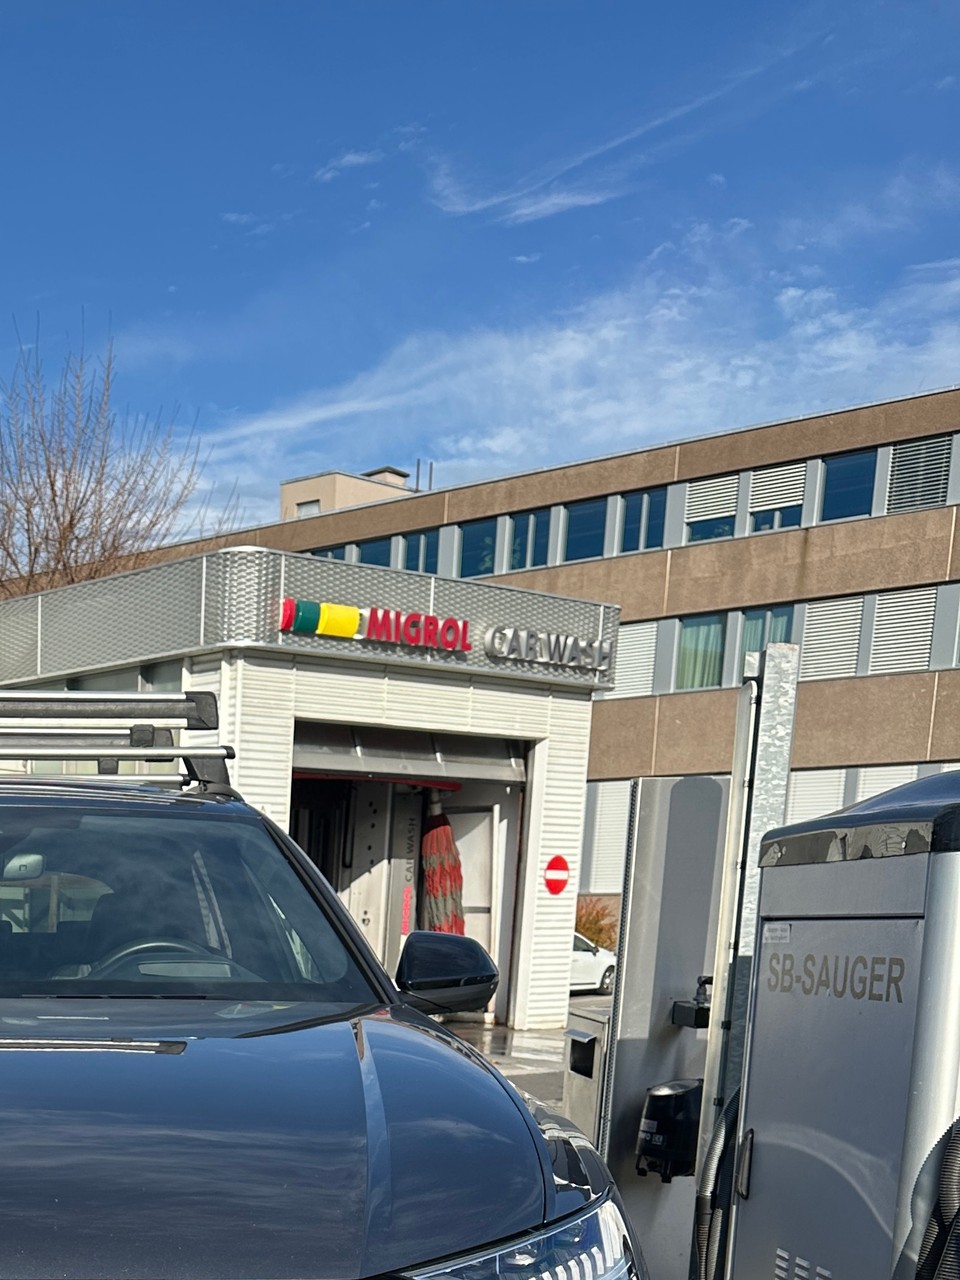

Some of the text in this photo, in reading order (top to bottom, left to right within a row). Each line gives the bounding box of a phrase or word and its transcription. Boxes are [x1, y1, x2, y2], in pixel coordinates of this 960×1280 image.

[366, 606, 613, 671] MIGROL CAR WASH
[406, 817, 417, 855] WASH
[767, 951, 906, 1004] SB-SAUGER
